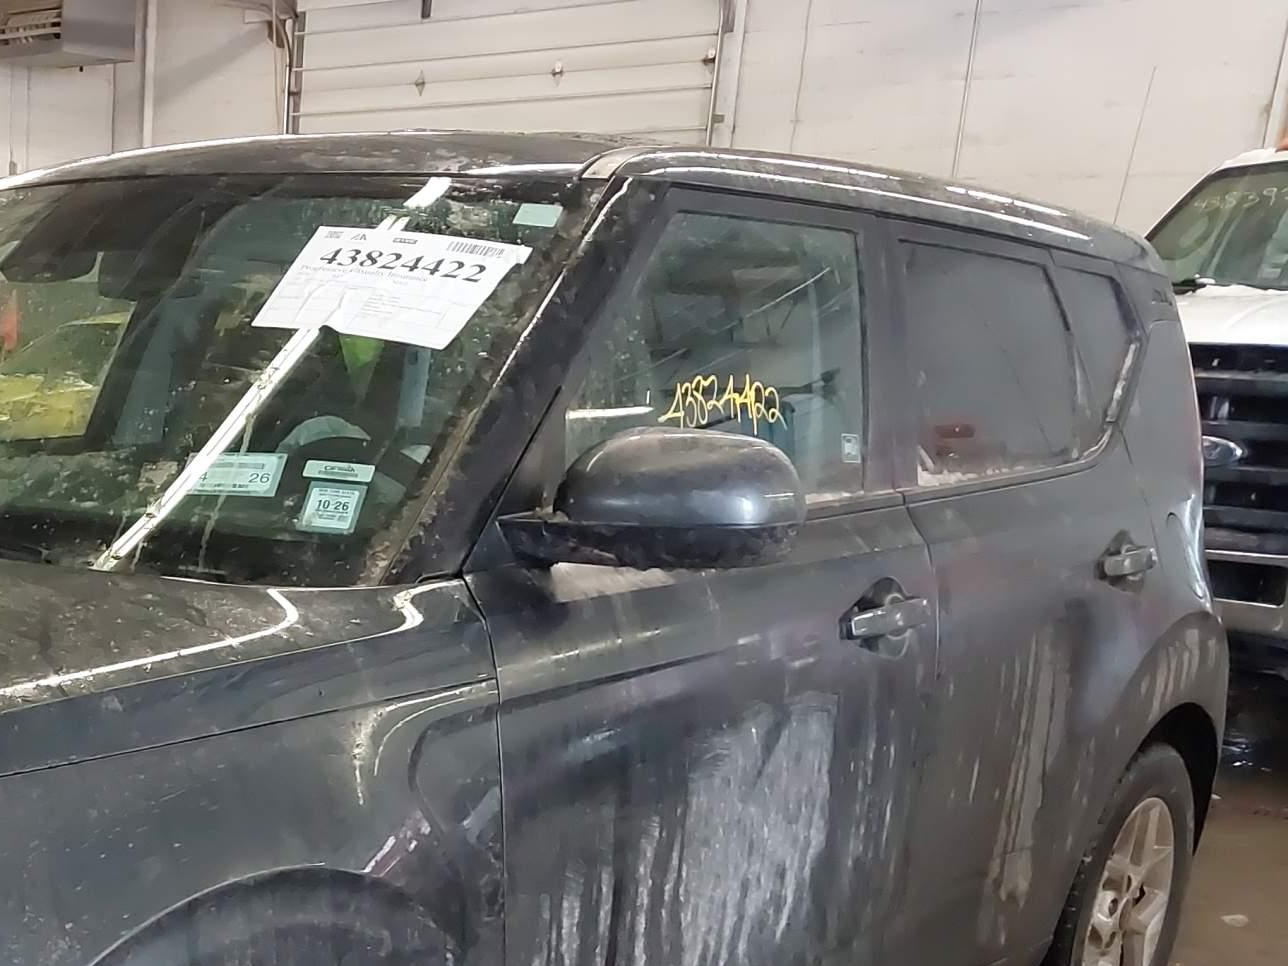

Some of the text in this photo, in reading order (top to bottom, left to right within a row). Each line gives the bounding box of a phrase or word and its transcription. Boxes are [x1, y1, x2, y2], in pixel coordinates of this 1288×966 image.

[319, 247, 487, 283] 43824422
[657, 373, 788, 436] 43824422
[248, 472, 271, 484] 26
[316, 499, 350, 511] 10 26
